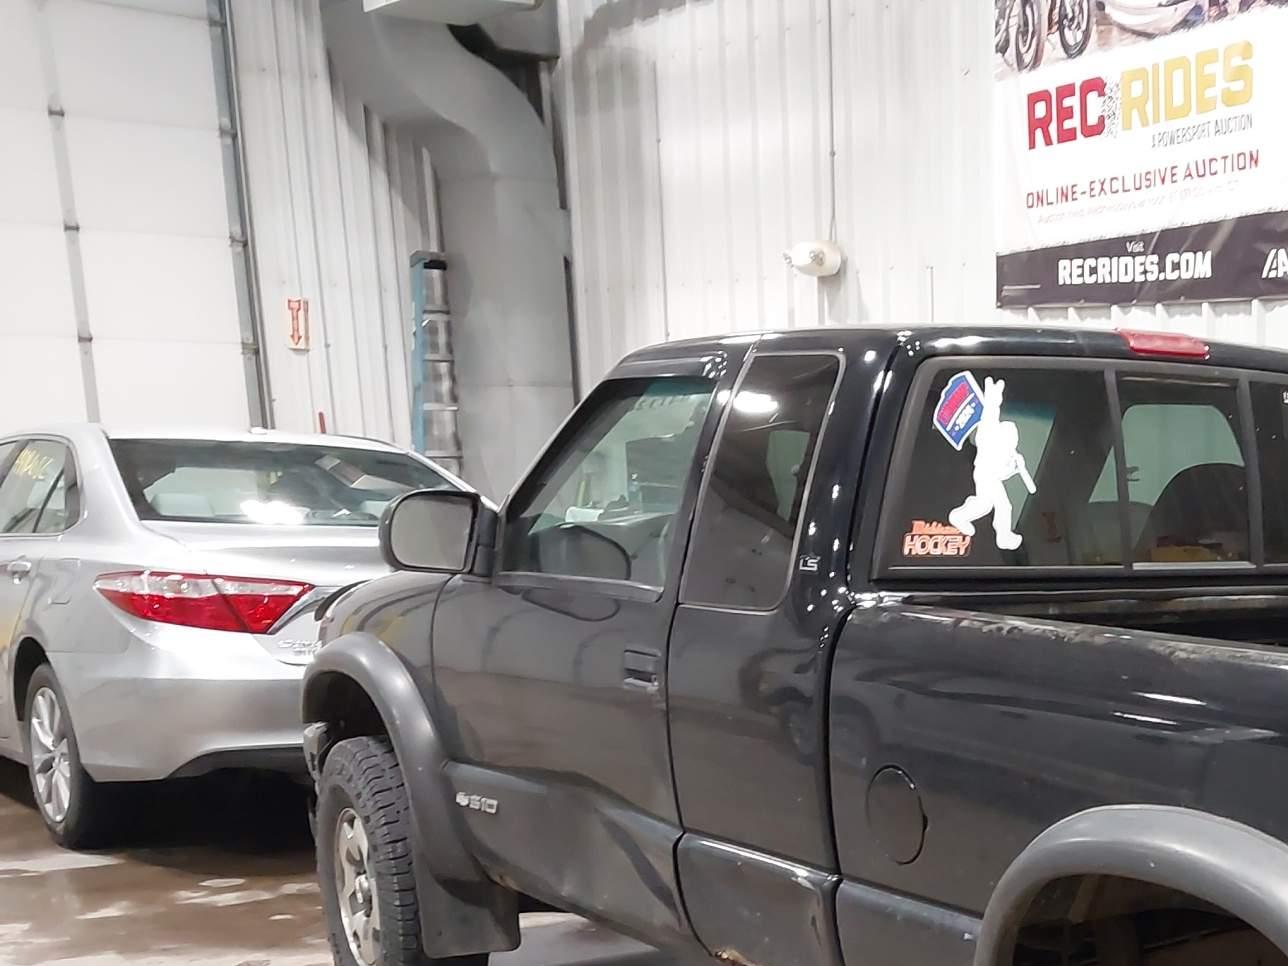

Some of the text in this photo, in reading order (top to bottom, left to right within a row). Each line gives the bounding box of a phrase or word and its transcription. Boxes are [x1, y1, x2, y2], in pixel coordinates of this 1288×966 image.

[1027, 40, 1253, 150] REC RIDES
[1158, 121, 1211, 147] POWERSPORT
[1214, 113, 1253, 136] AUCTION
[1026, 165, 1179, 209] ONLINE-EXCLUSIVE
[1183, 149, 1259, 180] AUCTION
[1058, 250, 1212, 285] RECRIDES.COM
[903, 535, 971, 556] HOCKEY
